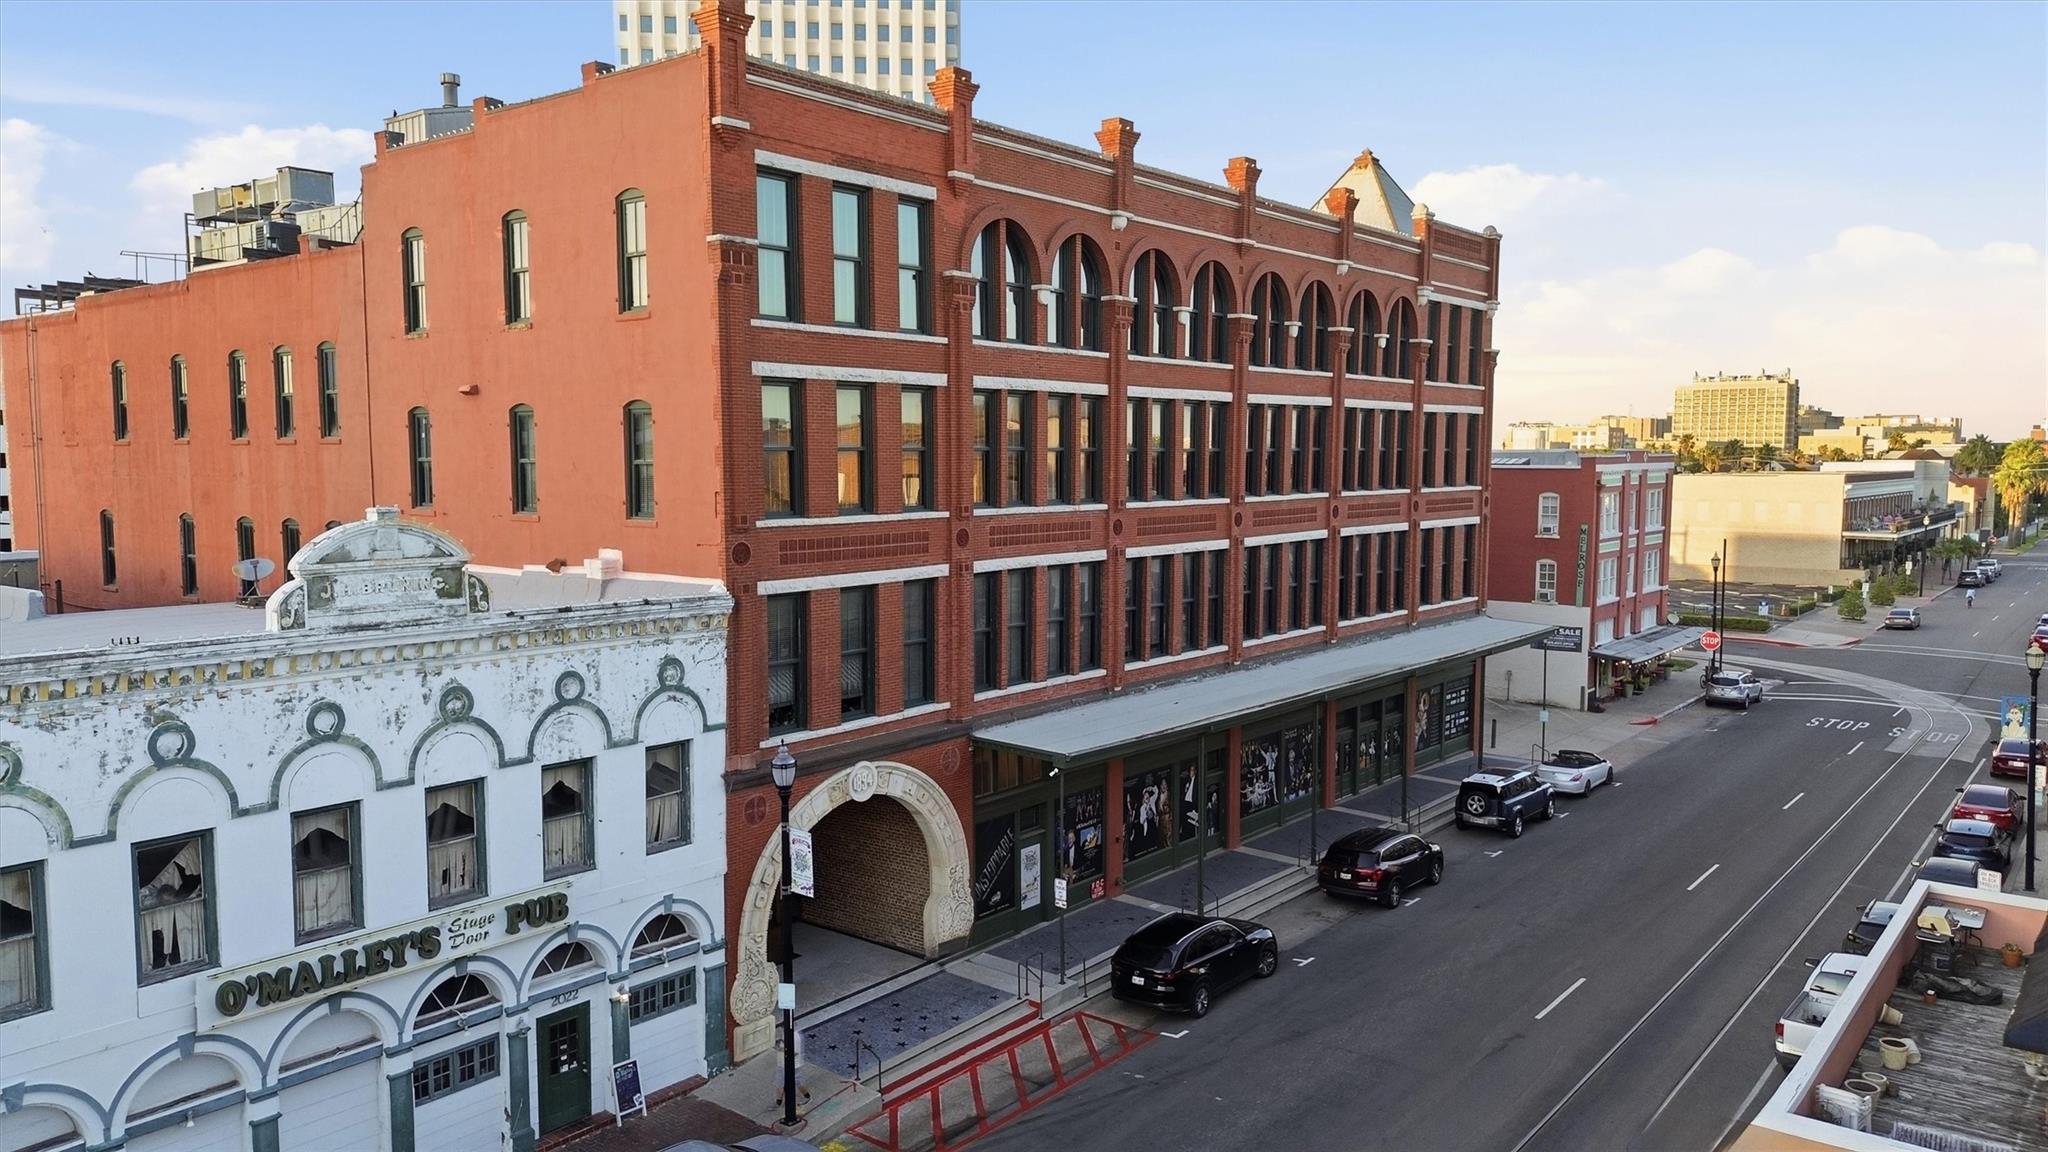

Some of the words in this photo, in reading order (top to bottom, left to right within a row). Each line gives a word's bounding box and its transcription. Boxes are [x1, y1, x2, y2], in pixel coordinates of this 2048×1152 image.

[1558, 627, 1581, 636] SALE
[1701, 635, 1720, 645] STOP
[1805, 717, 1870, 731] STOP
[1888, 727, 1961, 744] STOP
[853, 772, 873, 793] 1894
[448, 912, 496, 934] Stage
[448, 930, 490, 949] Door
[215, 925, 442, 1017] O'MALLEY'S
[505, 891, 569, 935] PUB
[551, 989, 579, 1008] 2022
